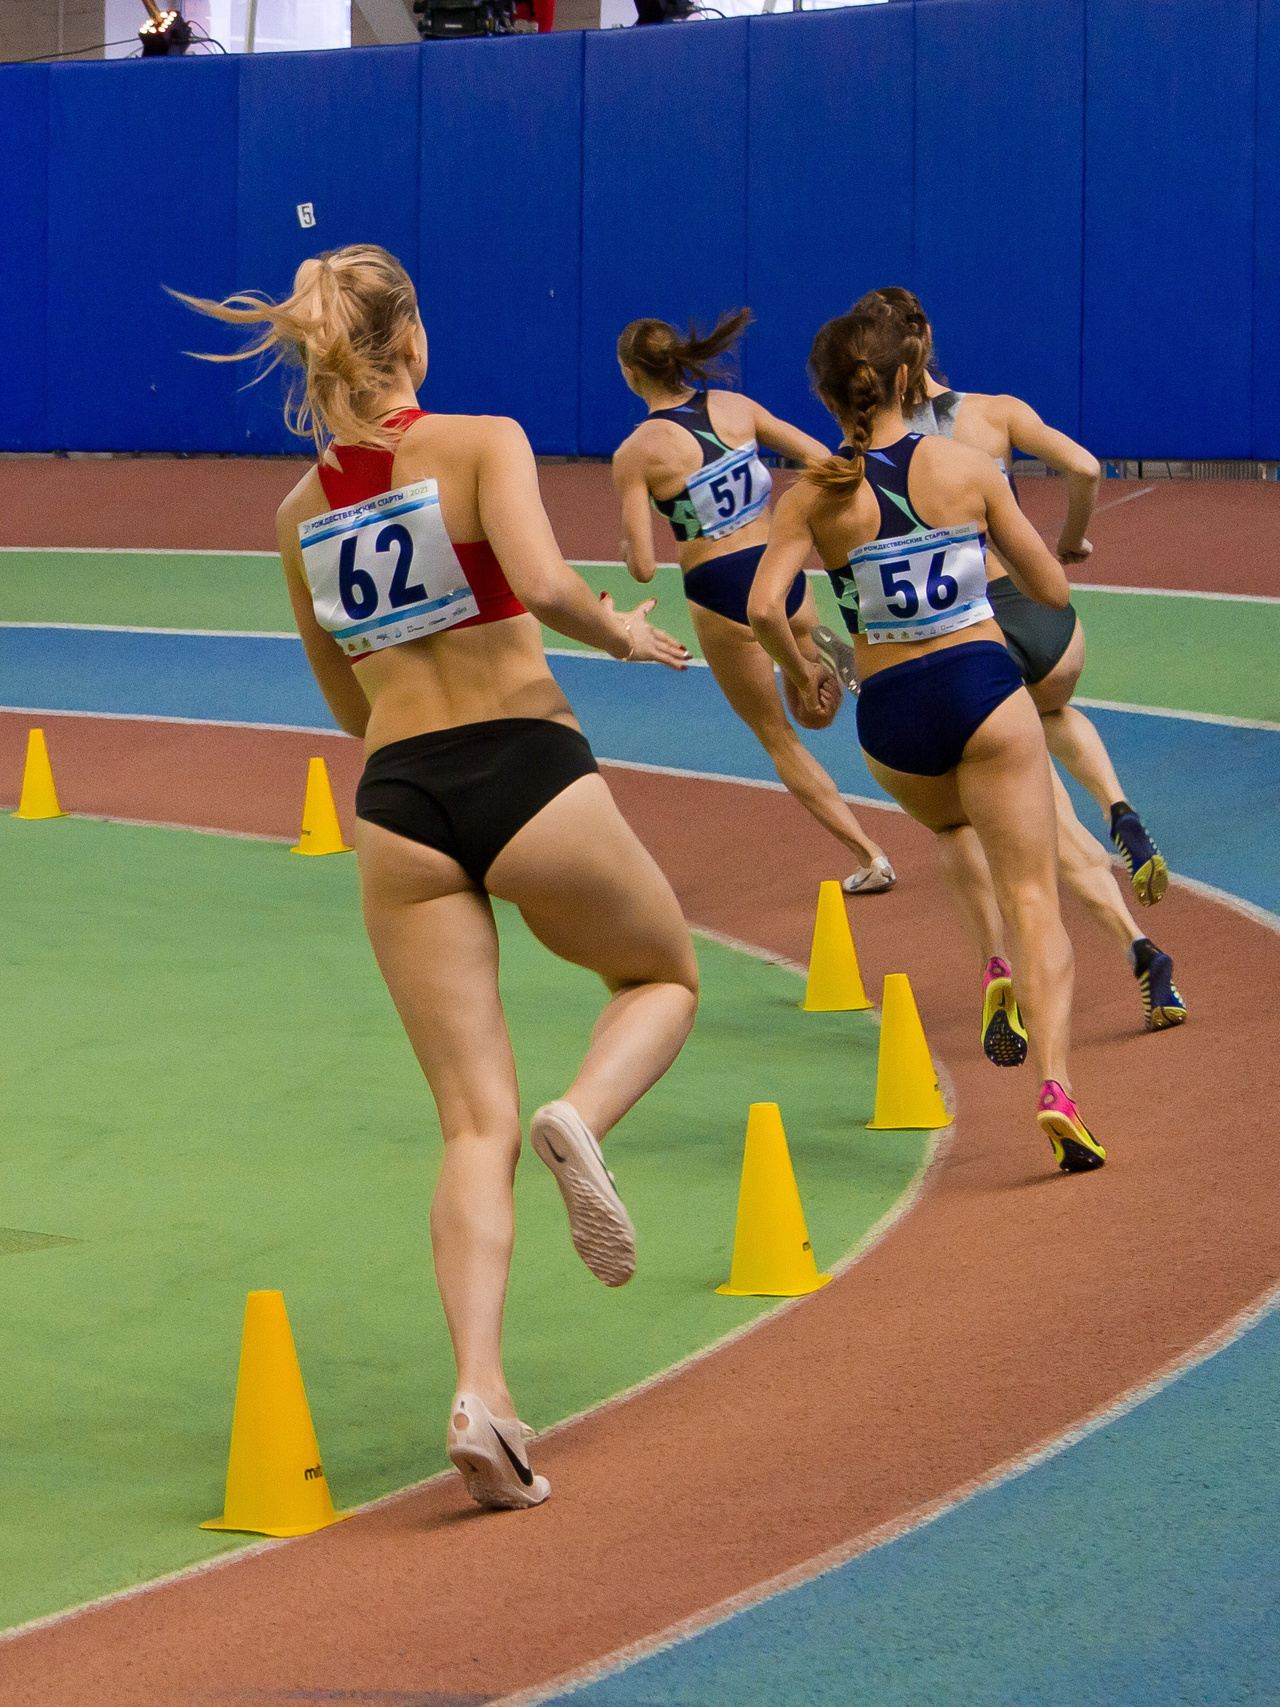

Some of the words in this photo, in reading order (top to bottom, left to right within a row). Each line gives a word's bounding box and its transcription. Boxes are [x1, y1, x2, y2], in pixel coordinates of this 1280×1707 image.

[301, 205, 312, 225] 5
[311, 502, 377, 530] РОЖДЕСТВЕНСКИЕ
[378, 493, 404, 507] СТАРТЫ
[410, 486, 428, 497] 2021
[709, 462, 753, 518] 57
[863, 536, 923, 552] РОЖДЕСТВЕНСКИЕ
[924, 530, 950, 541] СТАРТЫ
[339, 523, 429, 621] 62
[879, 550, 959, 619] 56
